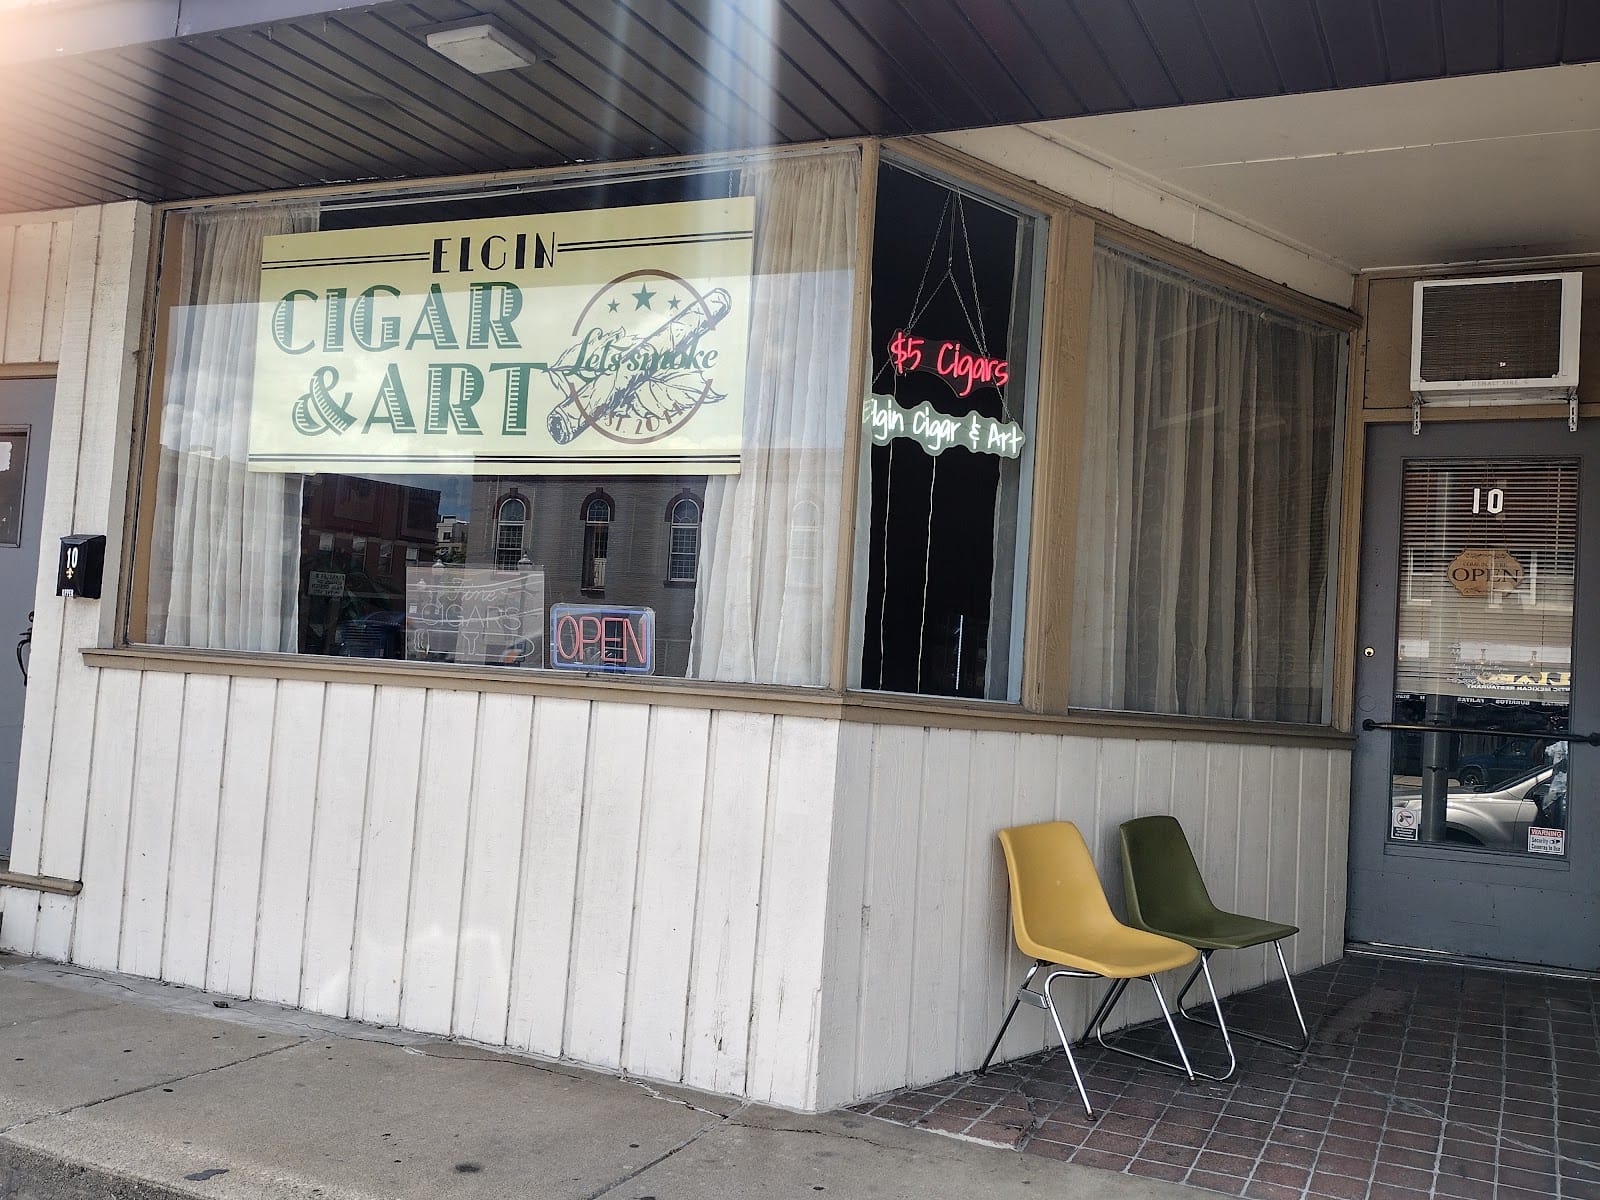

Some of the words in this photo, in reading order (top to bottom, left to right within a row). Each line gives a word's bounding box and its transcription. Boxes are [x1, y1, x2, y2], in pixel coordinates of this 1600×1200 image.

[431, 231, 557, 274] ELGIN
[271, 281, 524, 355] CIGAR
[626, 332, 719, 372] smoke
[890, 331, 925, 375] $5
[937, 342, 1009, 398] Cigars
[912, 406, 962, 451] Cigar
[968, 415, 982, 449] &
[987, 422, 1023, 454] Art
[1472, 487, 1504, 515] 10
[66, 547, 78, 568] 10
[1452, 567, 1519, 582] OPEN
[421, 603, 522, 631] CIGARS
[557, 615, 647, 664] OPEN
[1530, 829, 1562, 838] WARNING
